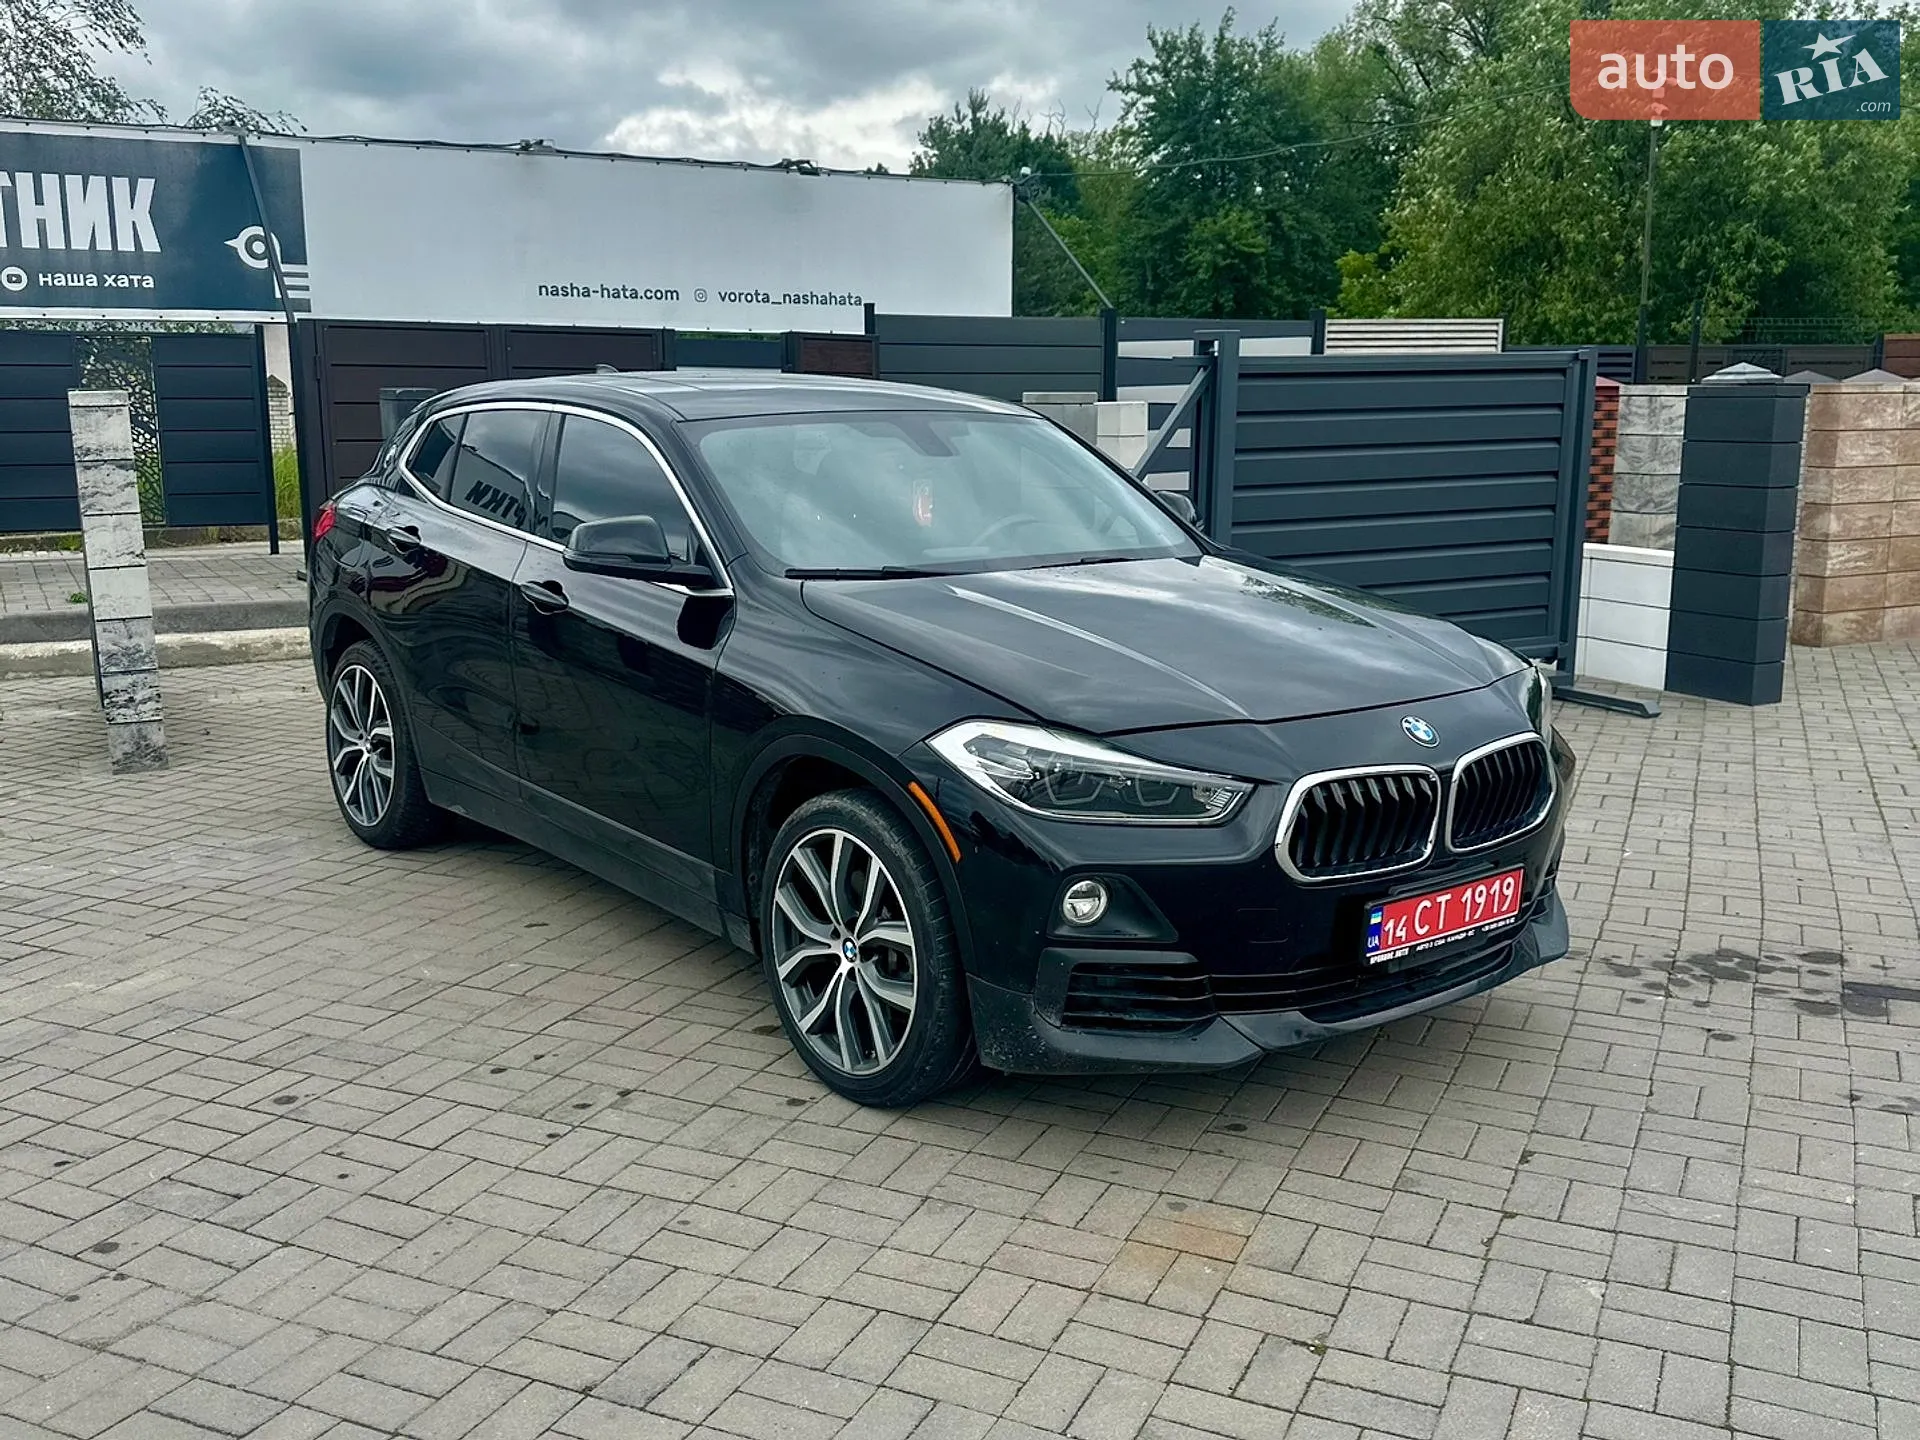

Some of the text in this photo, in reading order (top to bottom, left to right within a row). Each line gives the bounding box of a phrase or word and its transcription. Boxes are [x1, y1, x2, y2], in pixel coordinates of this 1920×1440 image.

[39, 272, 155, 289] наша хата
[538, 282, 863, 307] nasha-hata.com vorota_nashahata
[1384, 876, 1516, 946] 14 CT 1919
[1367, 936, 1380, 948] UA
